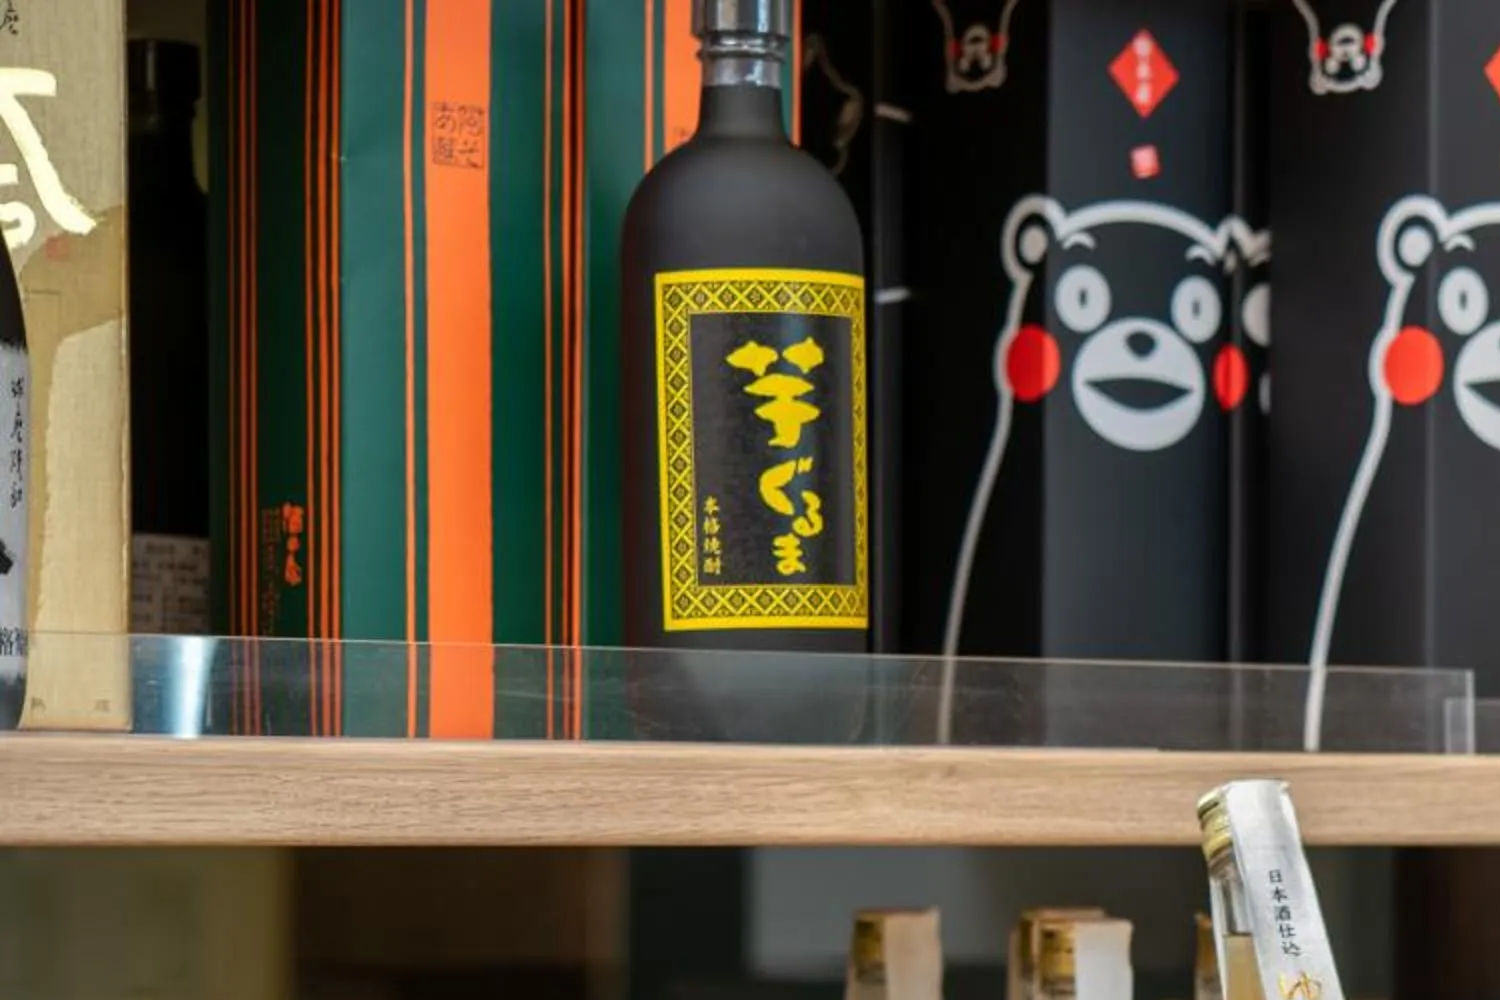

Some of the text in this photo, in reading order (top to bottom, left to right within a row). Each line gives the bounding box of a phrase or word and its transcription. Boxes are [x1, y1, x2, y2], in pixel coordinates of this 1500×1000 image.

[1268, 868, 1301, 957] 日本酒仕込
